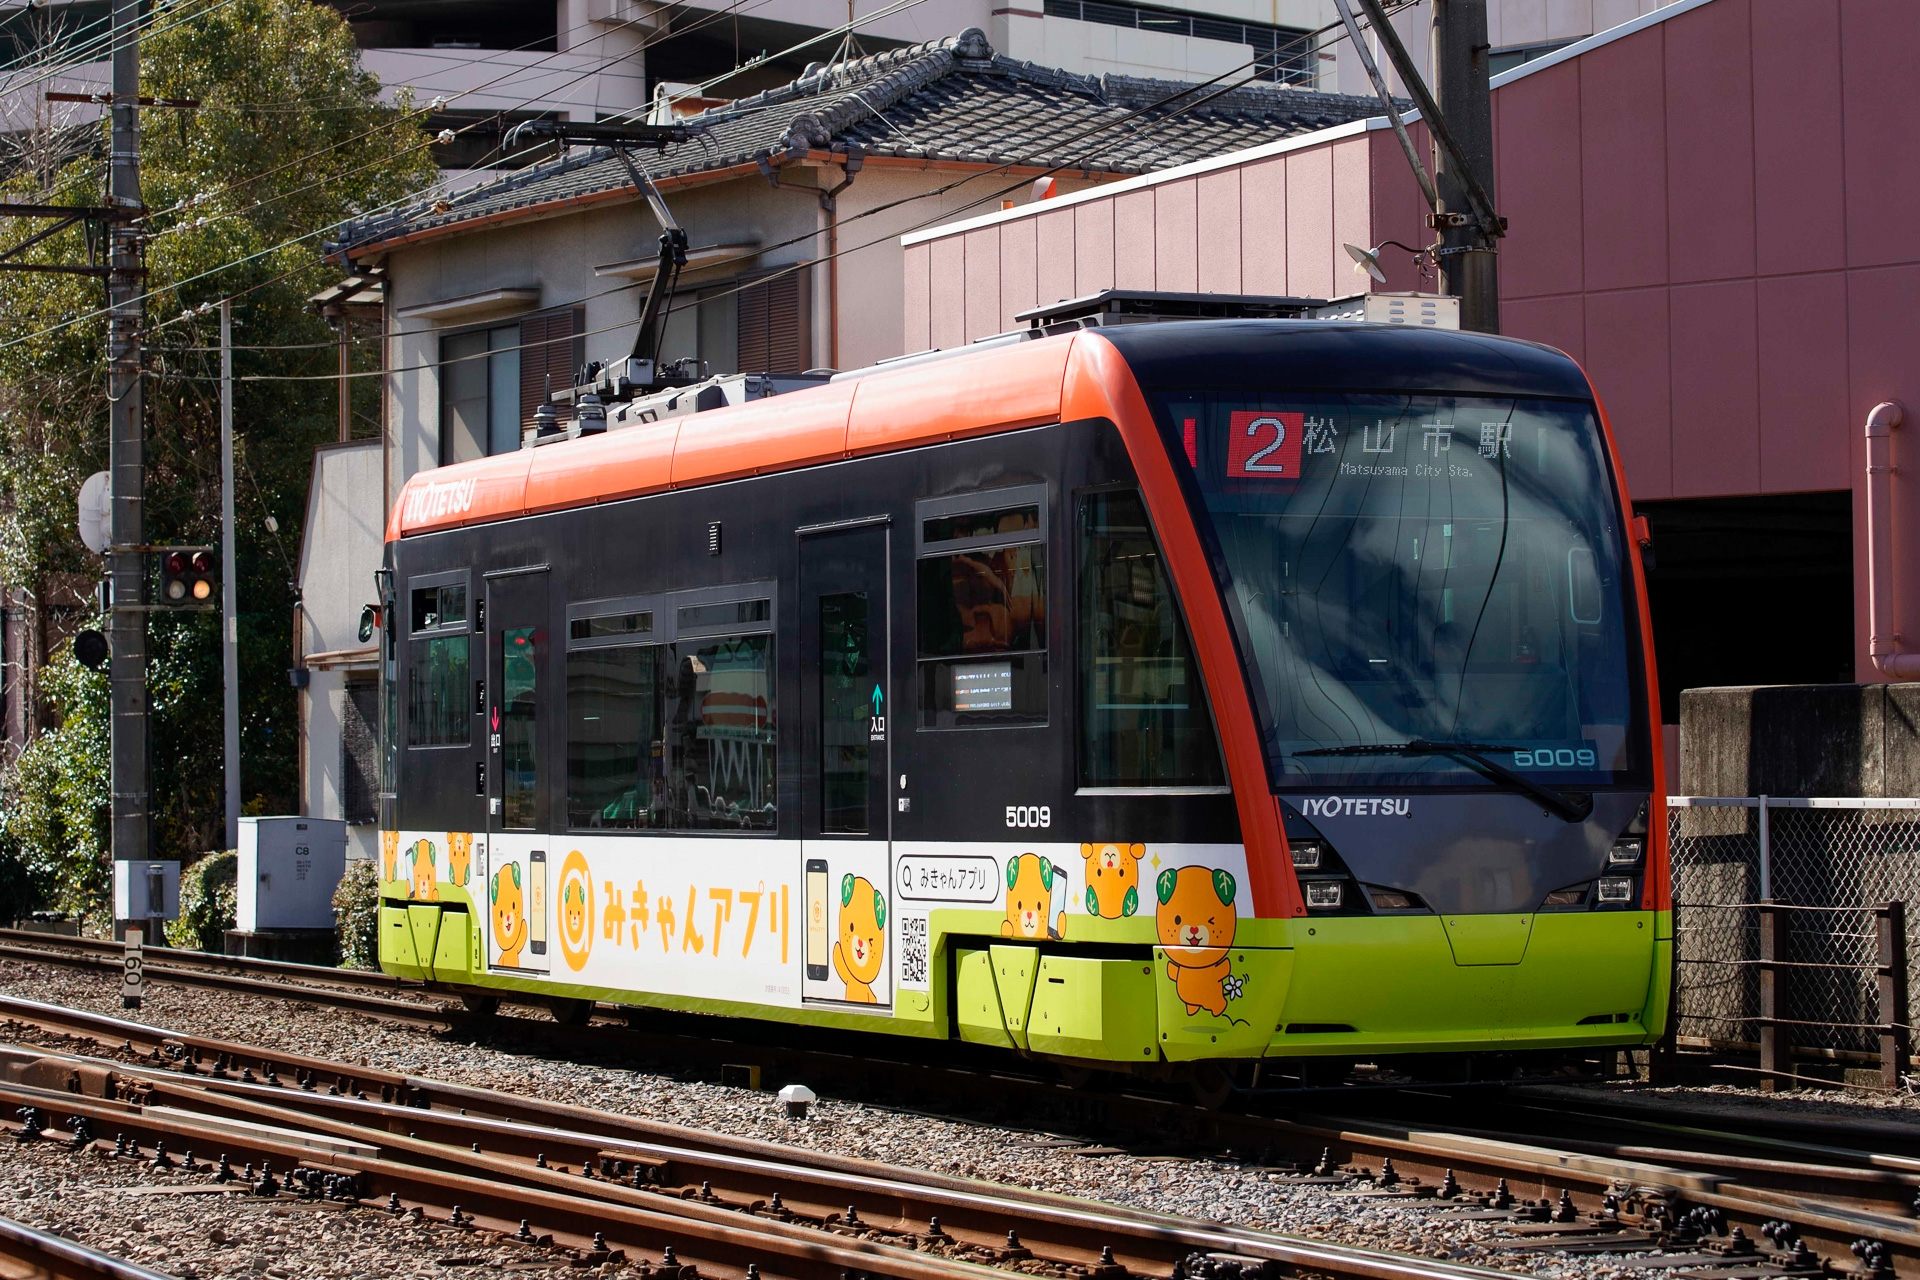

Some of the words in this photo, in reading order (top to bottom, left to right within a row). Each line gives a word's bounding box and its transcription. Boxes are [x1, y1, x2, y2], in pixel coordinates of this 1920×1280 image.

[1244, 416, 1286, 473] 2
[1302, 416, 1513, 459] 松山市駅
[1340, 461, 1409, 477] Matsuyama
[1415, 464, 1443, 478] City
[1448, 465, 1474, 478] Sta.
[406, 477, 478, 523] IYOTETSU
[870, 716, 886, 732] 入口
[1513, 748, 1597, 767] 5009
[1005, 805, 1051, 828] 5009
[1301, 795, 1410, 818] IYOTETSU
[295, 846, 310, 856] C8
[919, 866, 987, 891] みきゃんアプリ
[602, 878, 790, 965] みきゃんアプリ
[124, 943, 143, 986] 160
